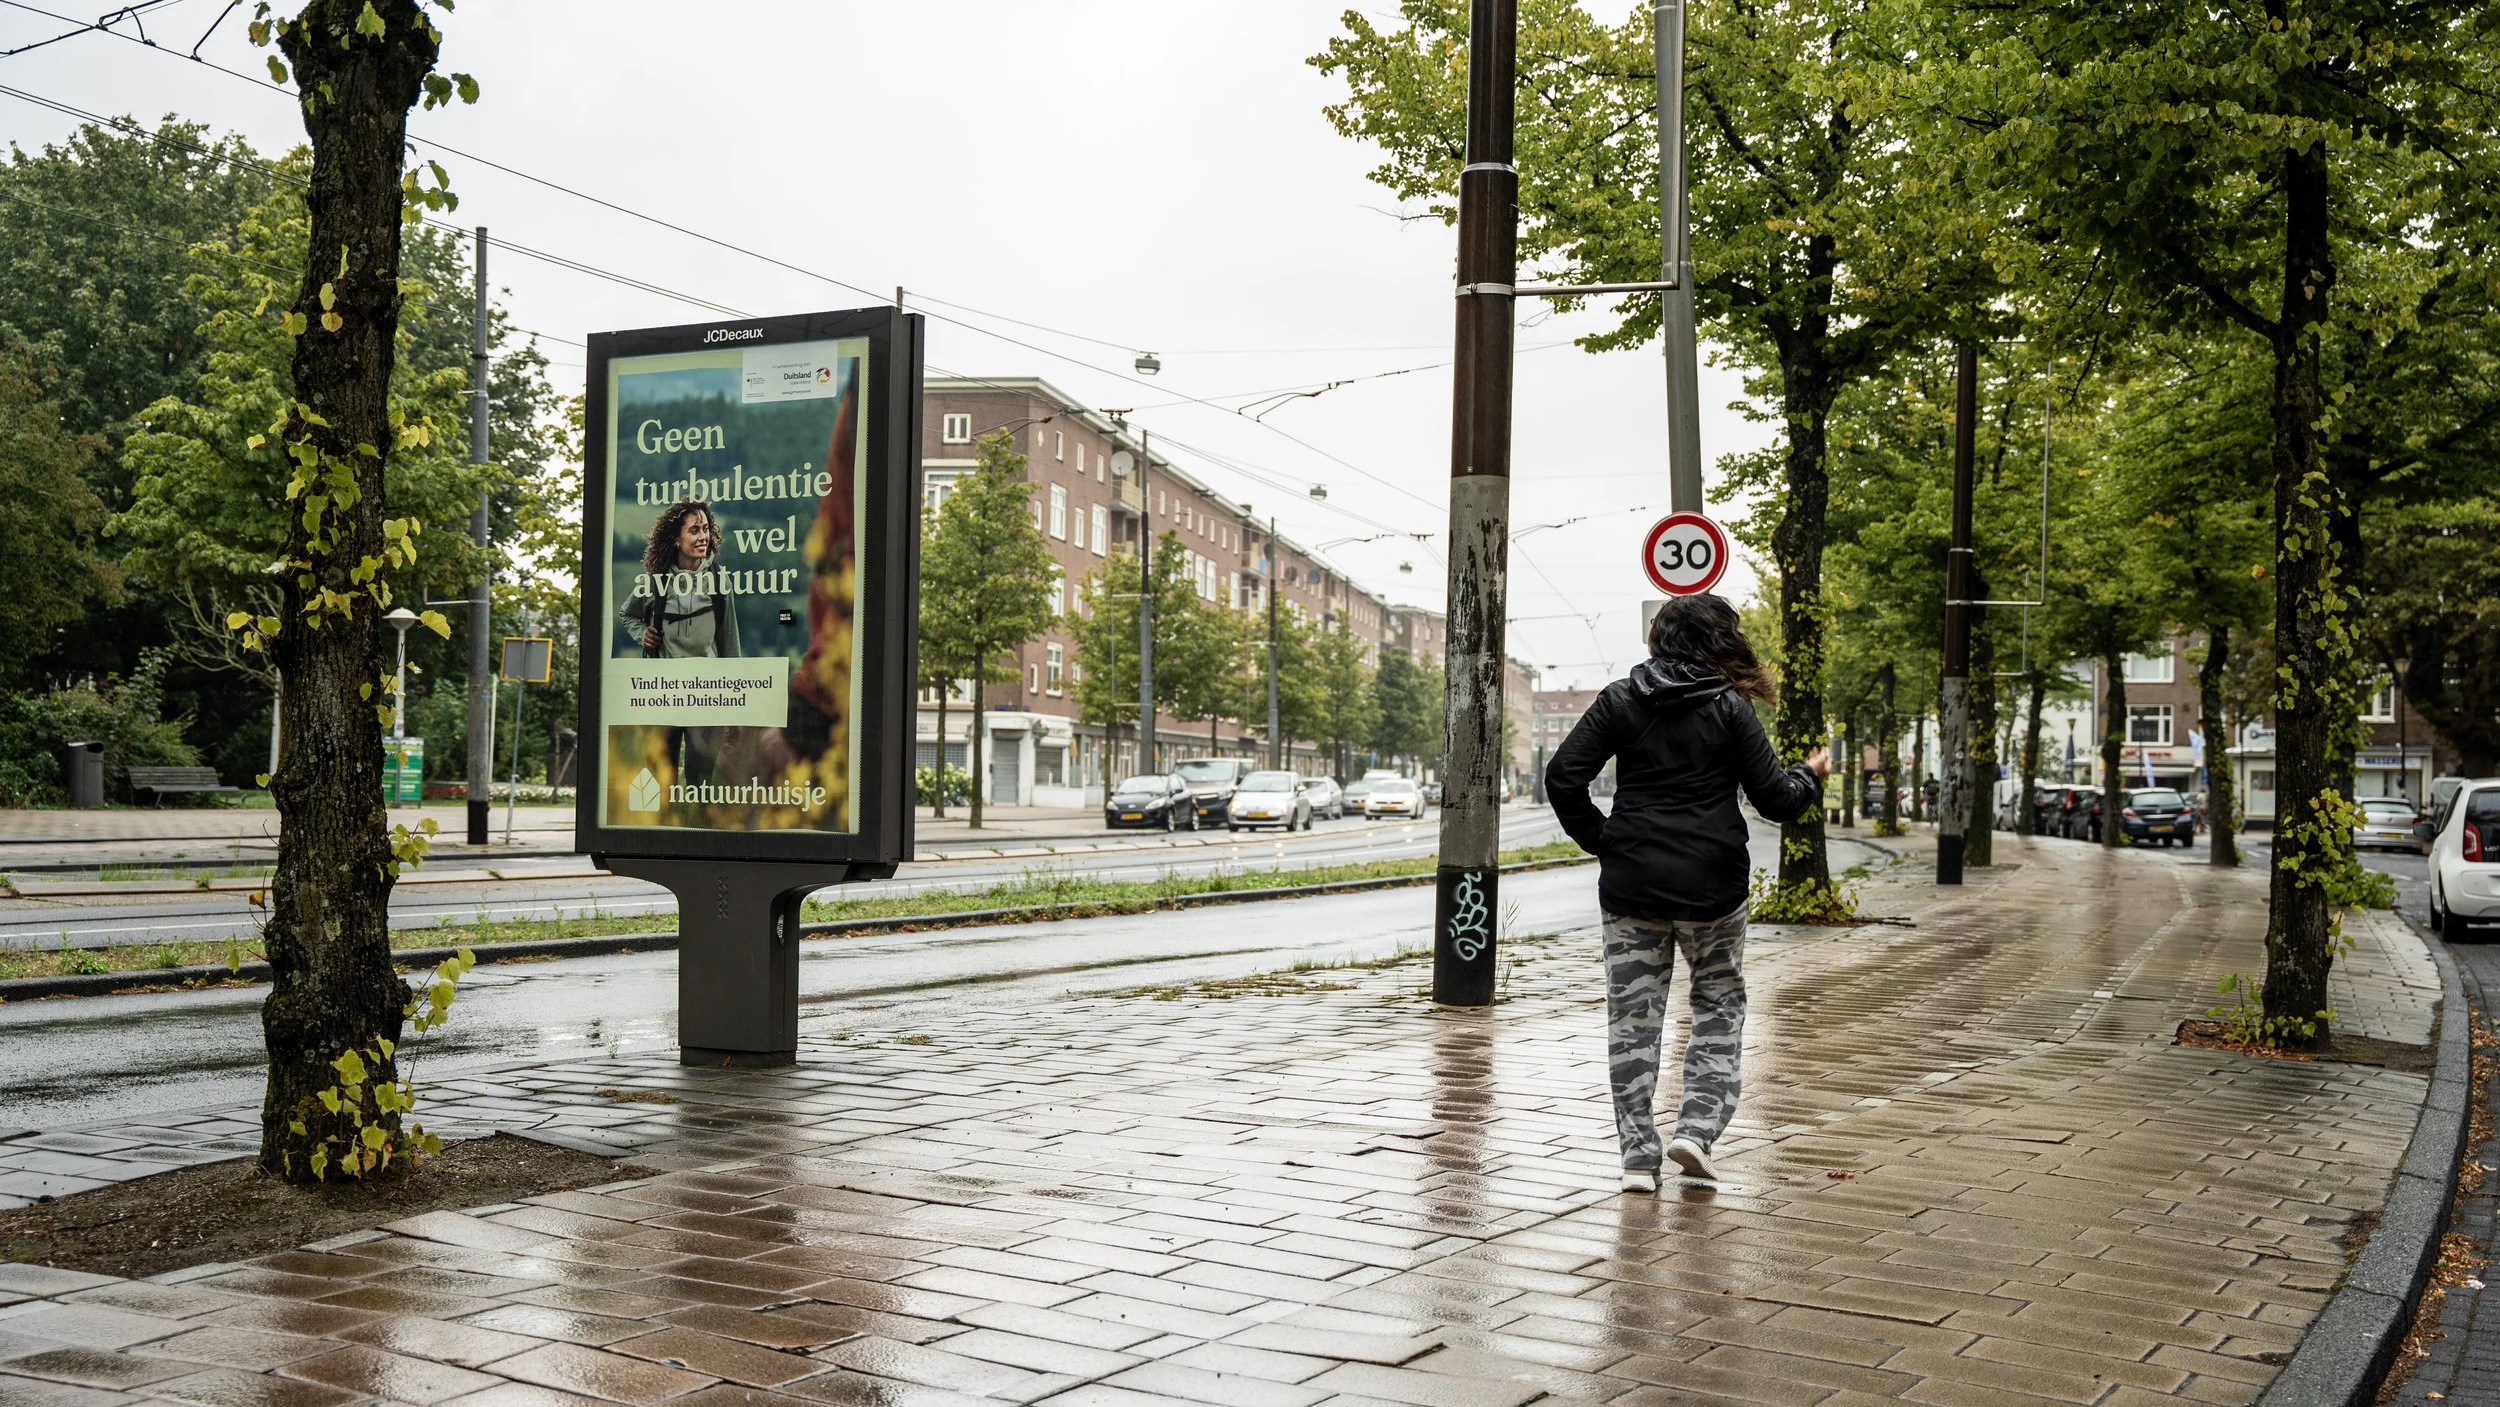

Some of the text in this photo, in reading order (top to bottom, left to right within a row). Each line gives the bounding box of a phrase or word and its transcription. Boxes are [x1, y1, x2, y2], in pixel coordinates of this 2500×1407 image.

[703, 328, 764, 344] JCDecaux
[783, 371, 812, 380] Duitsland
[636, 419, 725, 455] Geen
[635, 462, 833, 506] turbulentie
[734, 515, 797, 553] wel
[1659, 539, 1712, 571] 30
[633, 567, 798, 598] avontuur
[630, 676, 773, 692] Vind het vakantiegevoel
[630, 694, 746, 707] nu ook in Duitsland
[669, 777, 826, 812] natuurhuisje
